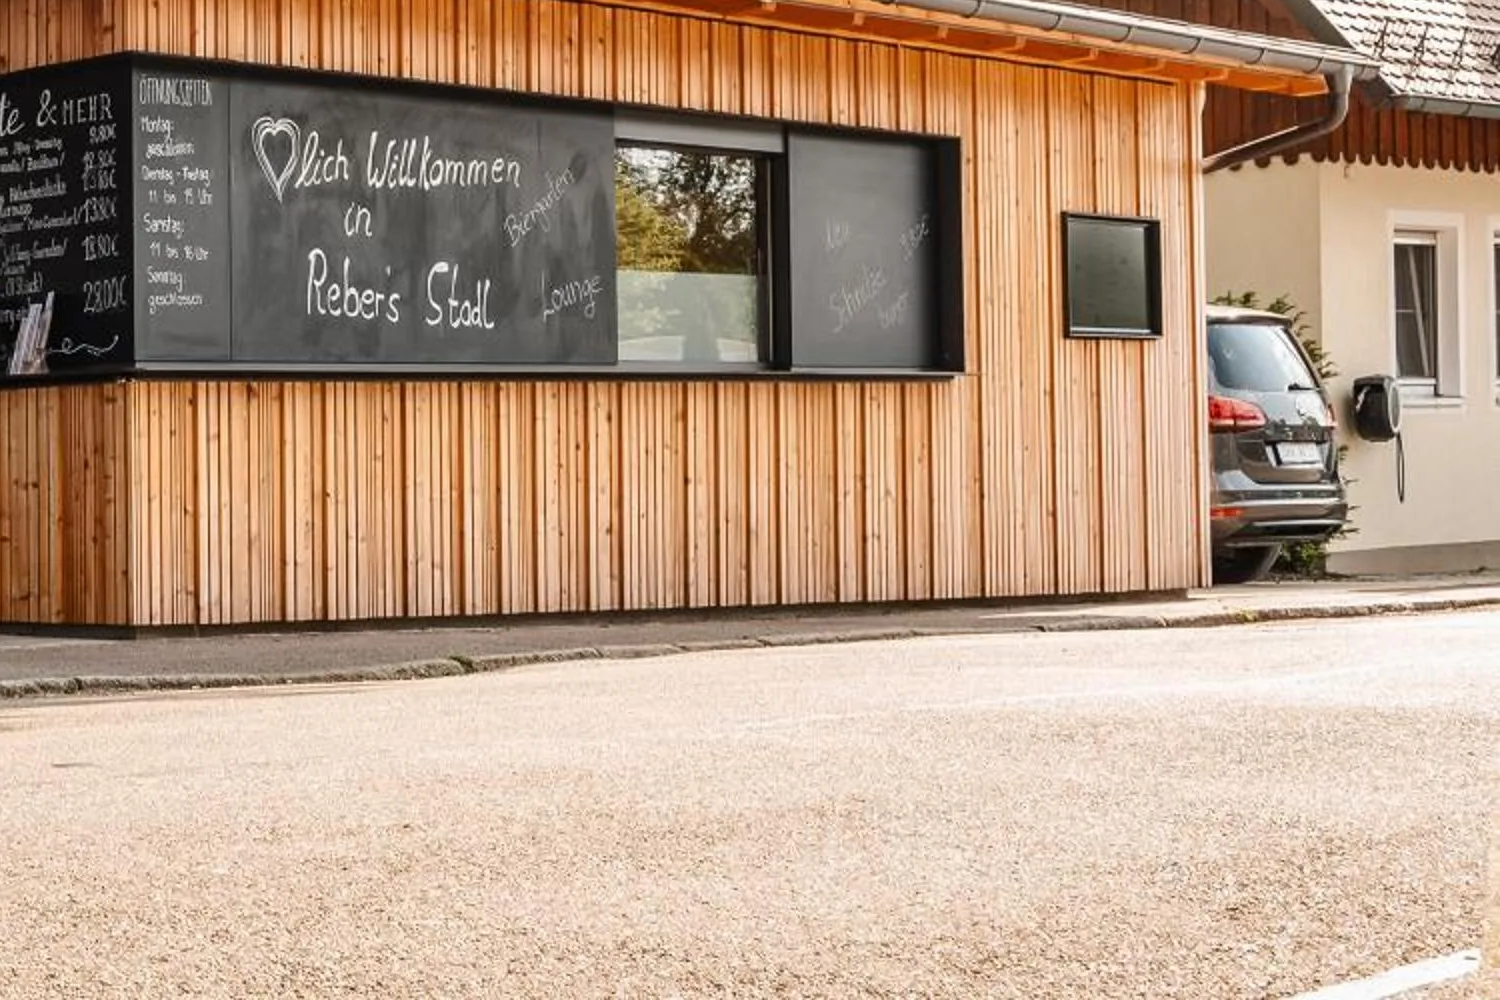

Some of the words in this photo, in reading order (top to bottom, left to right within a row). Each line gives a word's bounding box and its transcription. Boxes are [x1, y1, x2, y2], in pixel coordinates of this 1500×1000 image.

[36, 89, 57, 127] &
[63, 93, 113, 125] MEHR
[367, 131, 521, 191] Willkommen
[344, 202, 373, 237] in
[426, 261, 495, 329] Stadl
